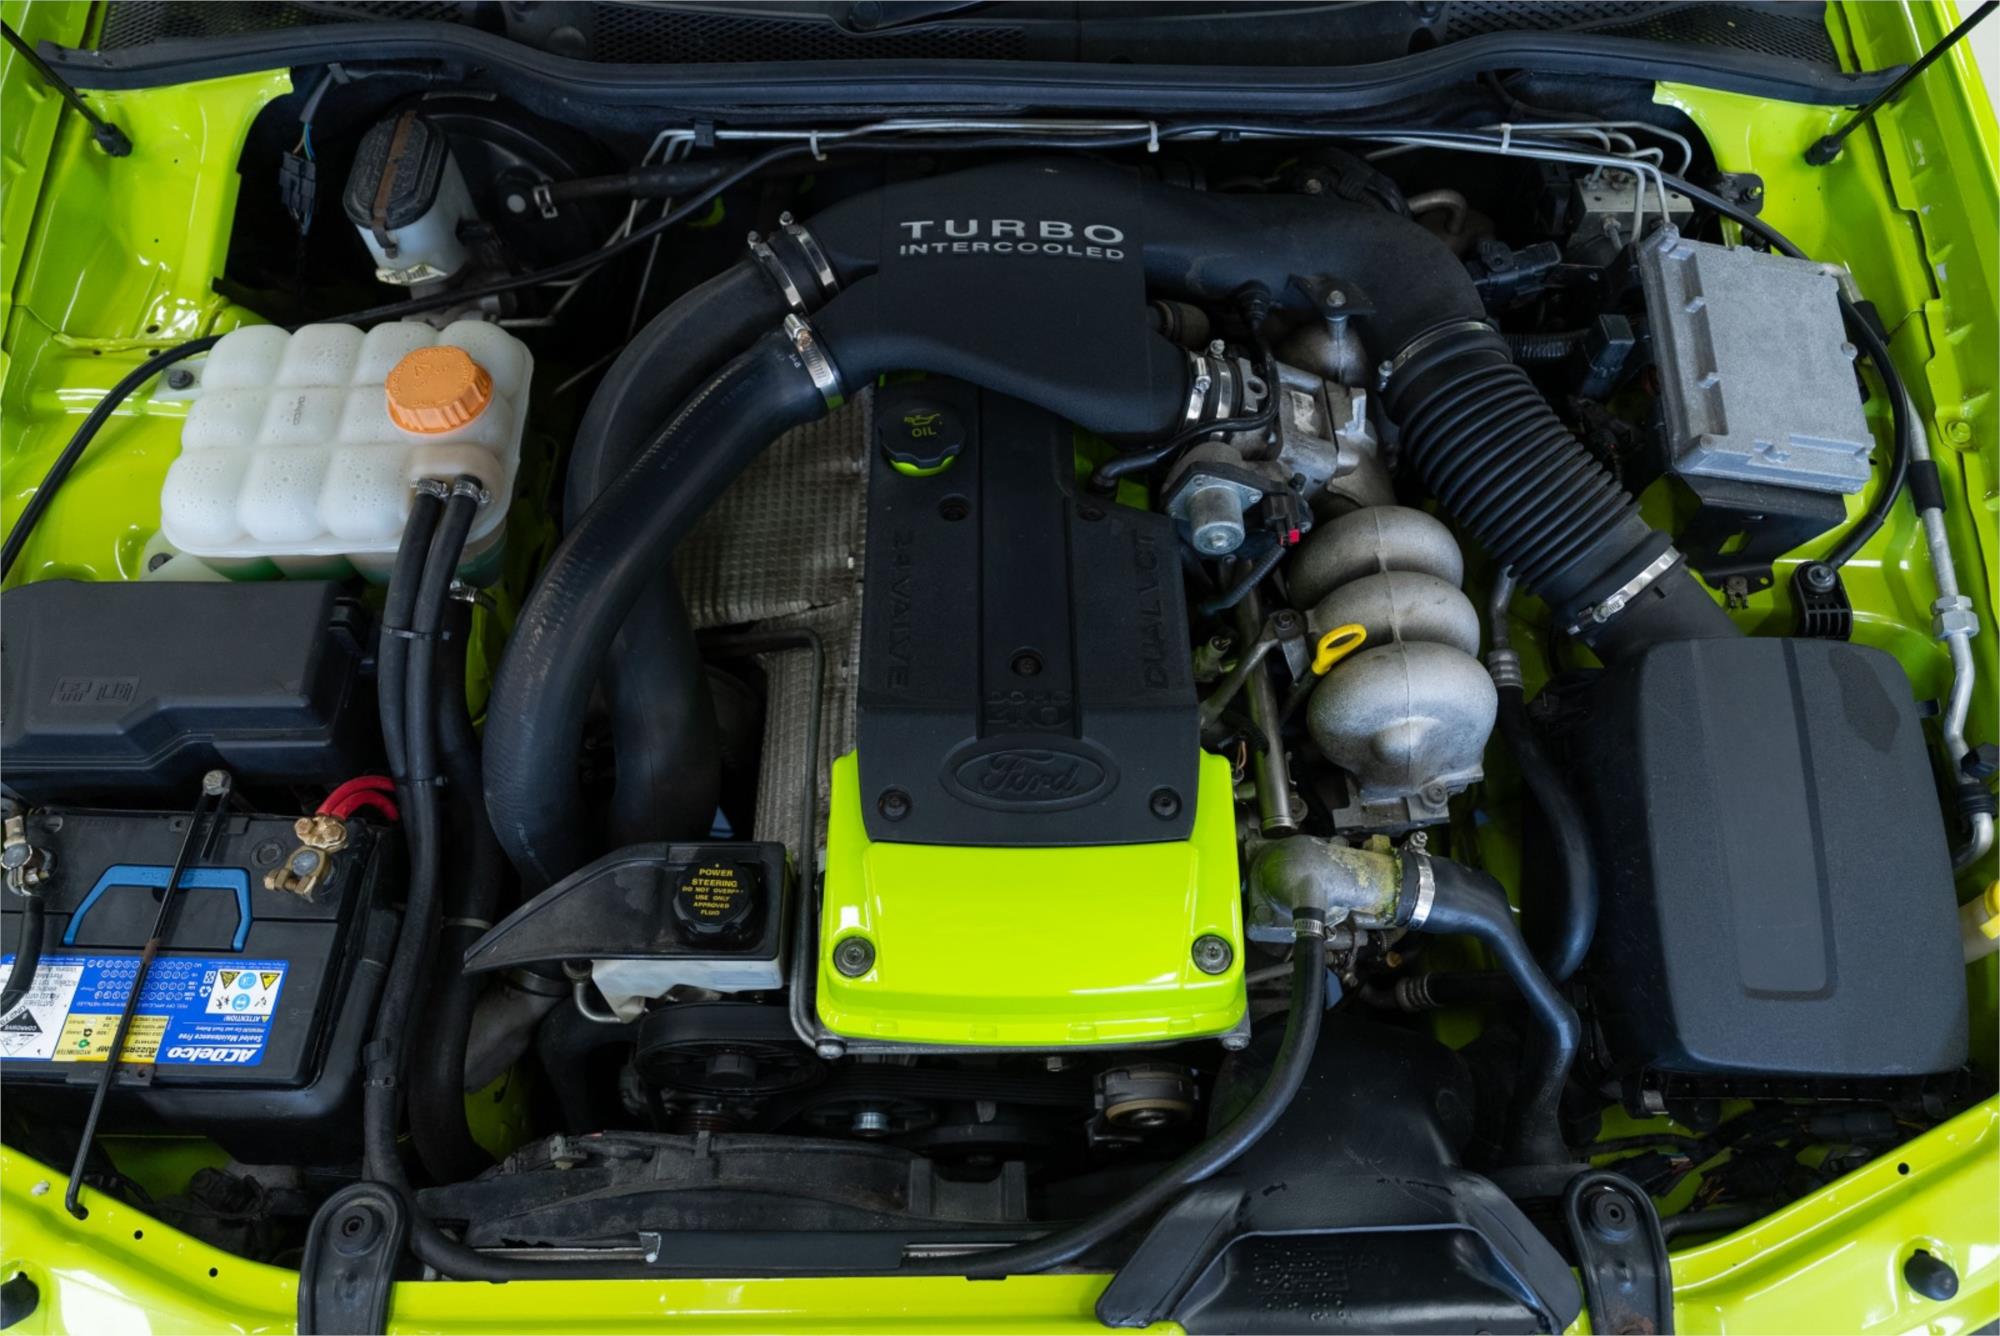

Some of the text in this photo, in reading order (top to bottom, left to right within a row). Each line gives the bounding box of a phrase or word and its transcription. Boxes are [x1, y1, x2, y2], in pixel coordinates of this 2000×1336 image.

[900, 219, 1125, 244] TURBO
[900, 241, 1125, 260] INTERCOOLED
[911, 427, 937, 438] OIL
[977, 752, 1081, 793] Ford
[699, 868, 734, 877] POWER
[691, 878, 738, 888] STEERING
[692, 901, 730, 909] APPROVED
[177, 1033, 263, 1043] Sealed Maintenance Free
[167, 1047, 257, 1063] ACDelco
